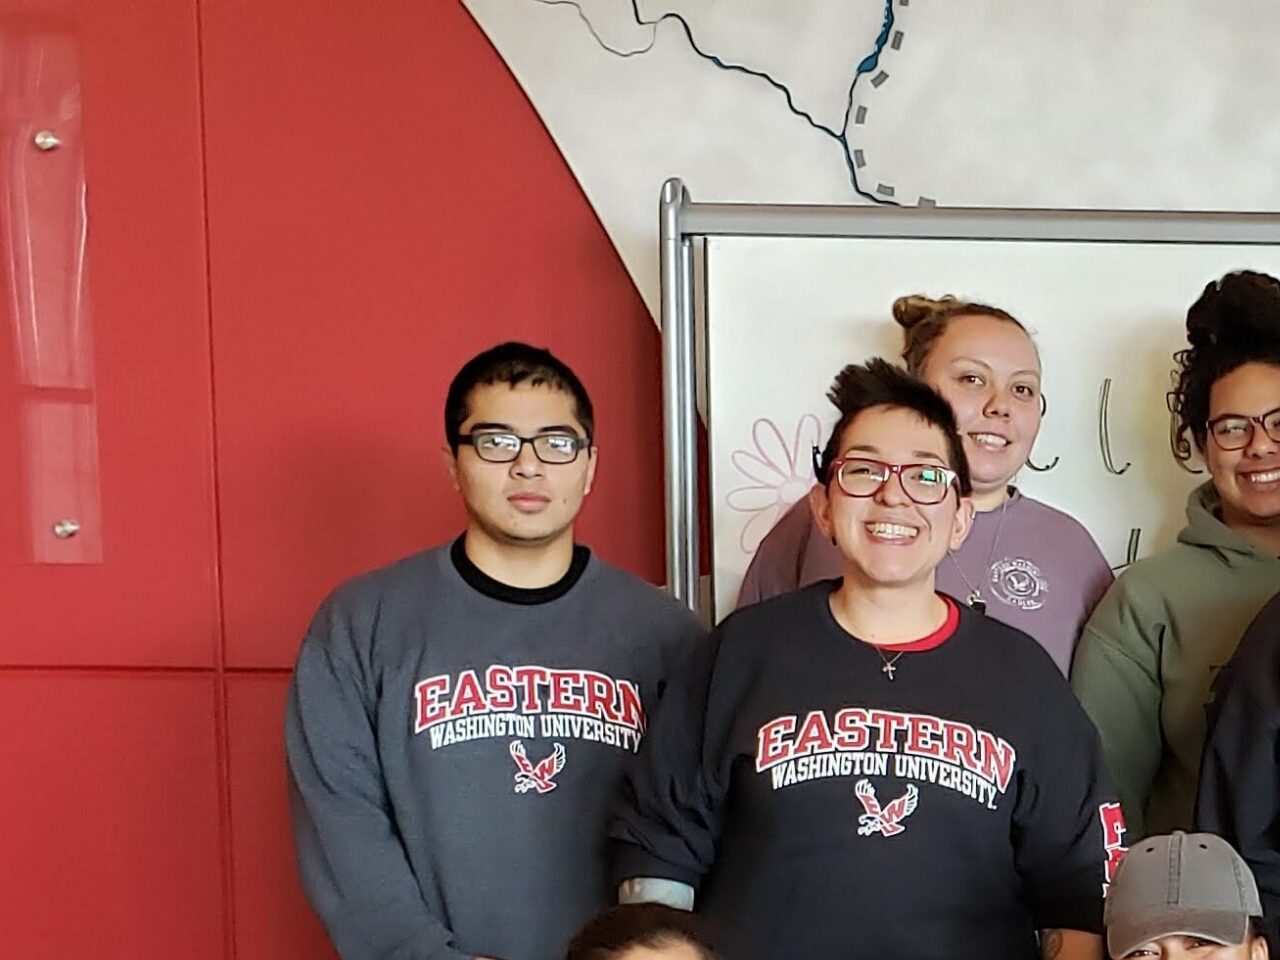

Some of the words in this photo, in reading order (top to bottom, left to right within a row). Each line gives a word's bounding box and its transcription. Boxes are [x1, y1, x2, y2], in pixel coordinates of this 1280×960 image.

[414, 664, 648, 734] EASTERN
[429, 713, 536, 750] WASHINGTON
[540, 714, 643, 754] UNIVERSITY
[755, 707, 1017, 795] EASTERN
[771, 751, 890, 790] WASHINGTON
